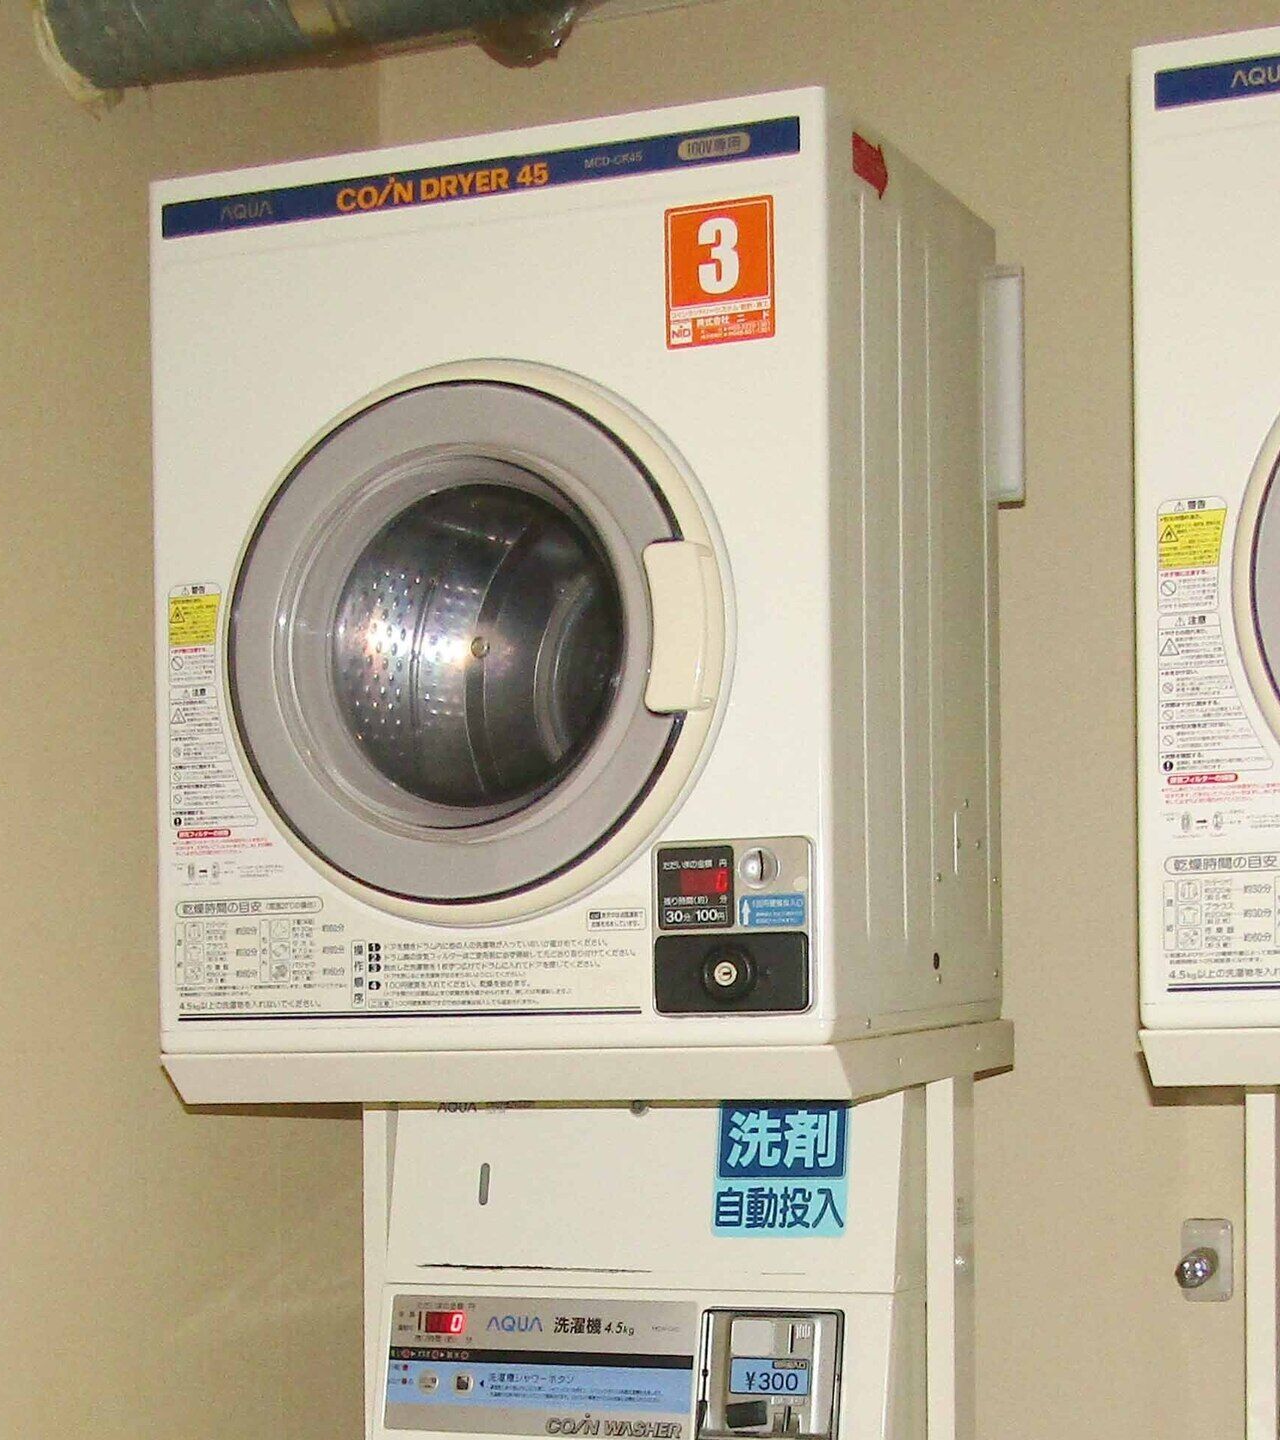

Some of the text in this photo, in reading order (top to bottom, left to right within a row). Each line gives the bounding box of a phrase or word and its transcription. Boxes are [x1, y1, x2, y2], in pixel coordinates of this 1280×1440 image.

[222, 200, 273, 222] AQUA
[421, 166, 511, 202] DRYER
[517, 162, 550, 189] 45
[697, 216, 740, 295] 3
[665, 908, 726, 923] 30分 100円
[727, 1109, 839, 1170] 洗剤
[714, 1187, 844, 1230] 自動投入
[450, 1313, 463, 1332] 0
[486, 1315, 635, 1337] AQUA 洗濯機 4.5kg
[746, 1371, 799, 1392] ¥300
[603, 1420, 683, 1440] WASHER
